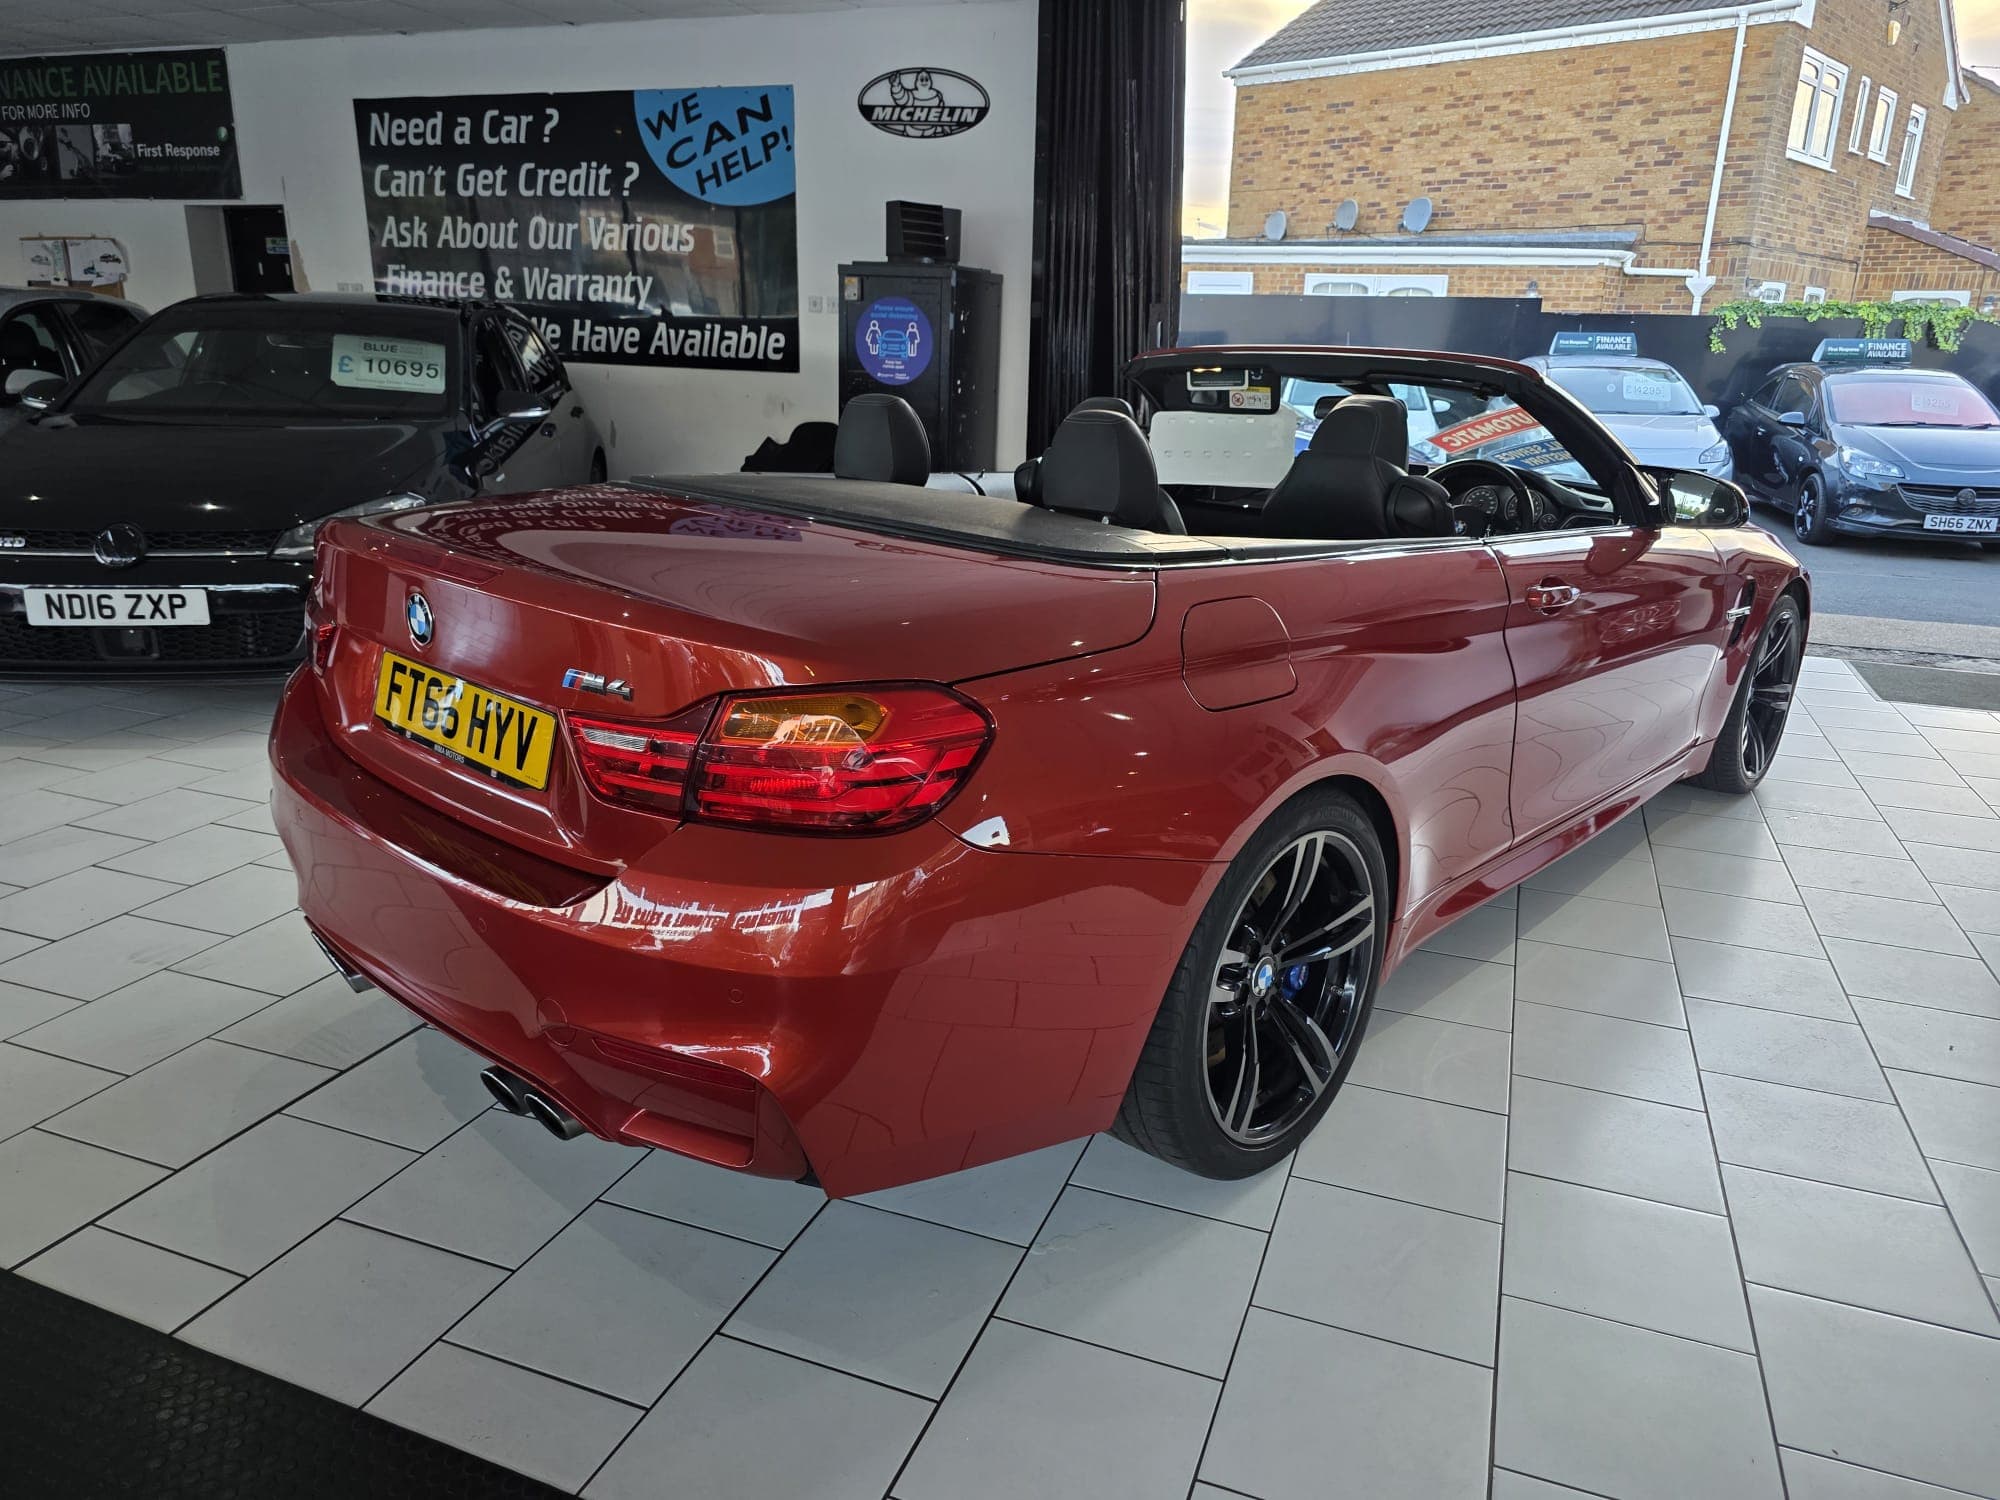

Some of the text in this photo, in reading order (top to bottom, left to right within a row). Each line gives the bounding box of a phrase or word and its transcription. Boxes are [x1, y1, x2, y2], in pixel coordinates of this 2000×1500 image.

[83, 60, 224, 97] AVAILABLE
[2, 103, 91, 120] FOR MORE INFO
[369, 111, 443, 146] Need
[454, 117, 471, 145] a
[482, 109, 533, 144] Car
[643, 92, 702, 141] WE
[871, 106, 978, 123] MICHELIN
[666, 93, 773, 169] CAN
[137, 143, 220, 160] First Response
[695, 125, 792, 196] HELP!
[374, 164, 446, 197] Can't
[457, 163, 508, 197] Get
[518, 161, 612, 197] Credit
[381, 215, 695, 252] Ask About Our Various
[386, 264, 653, 310] Finance & Warranty
[363, 342, 399, 353] BLUE
[571, 319, 641, 354] Have
[649, 322, 786, 360] Available
[1868, 342, 1907, 351] FINANCE
[365, 358, 439, 379] 10695
[1930, 516, 1992, 530] SH66 ZNX
[0, 537, 25, 547] TD
[44, 594, 187, 620] ND16 ZXP
[466, 693, 538, 771] HYV
